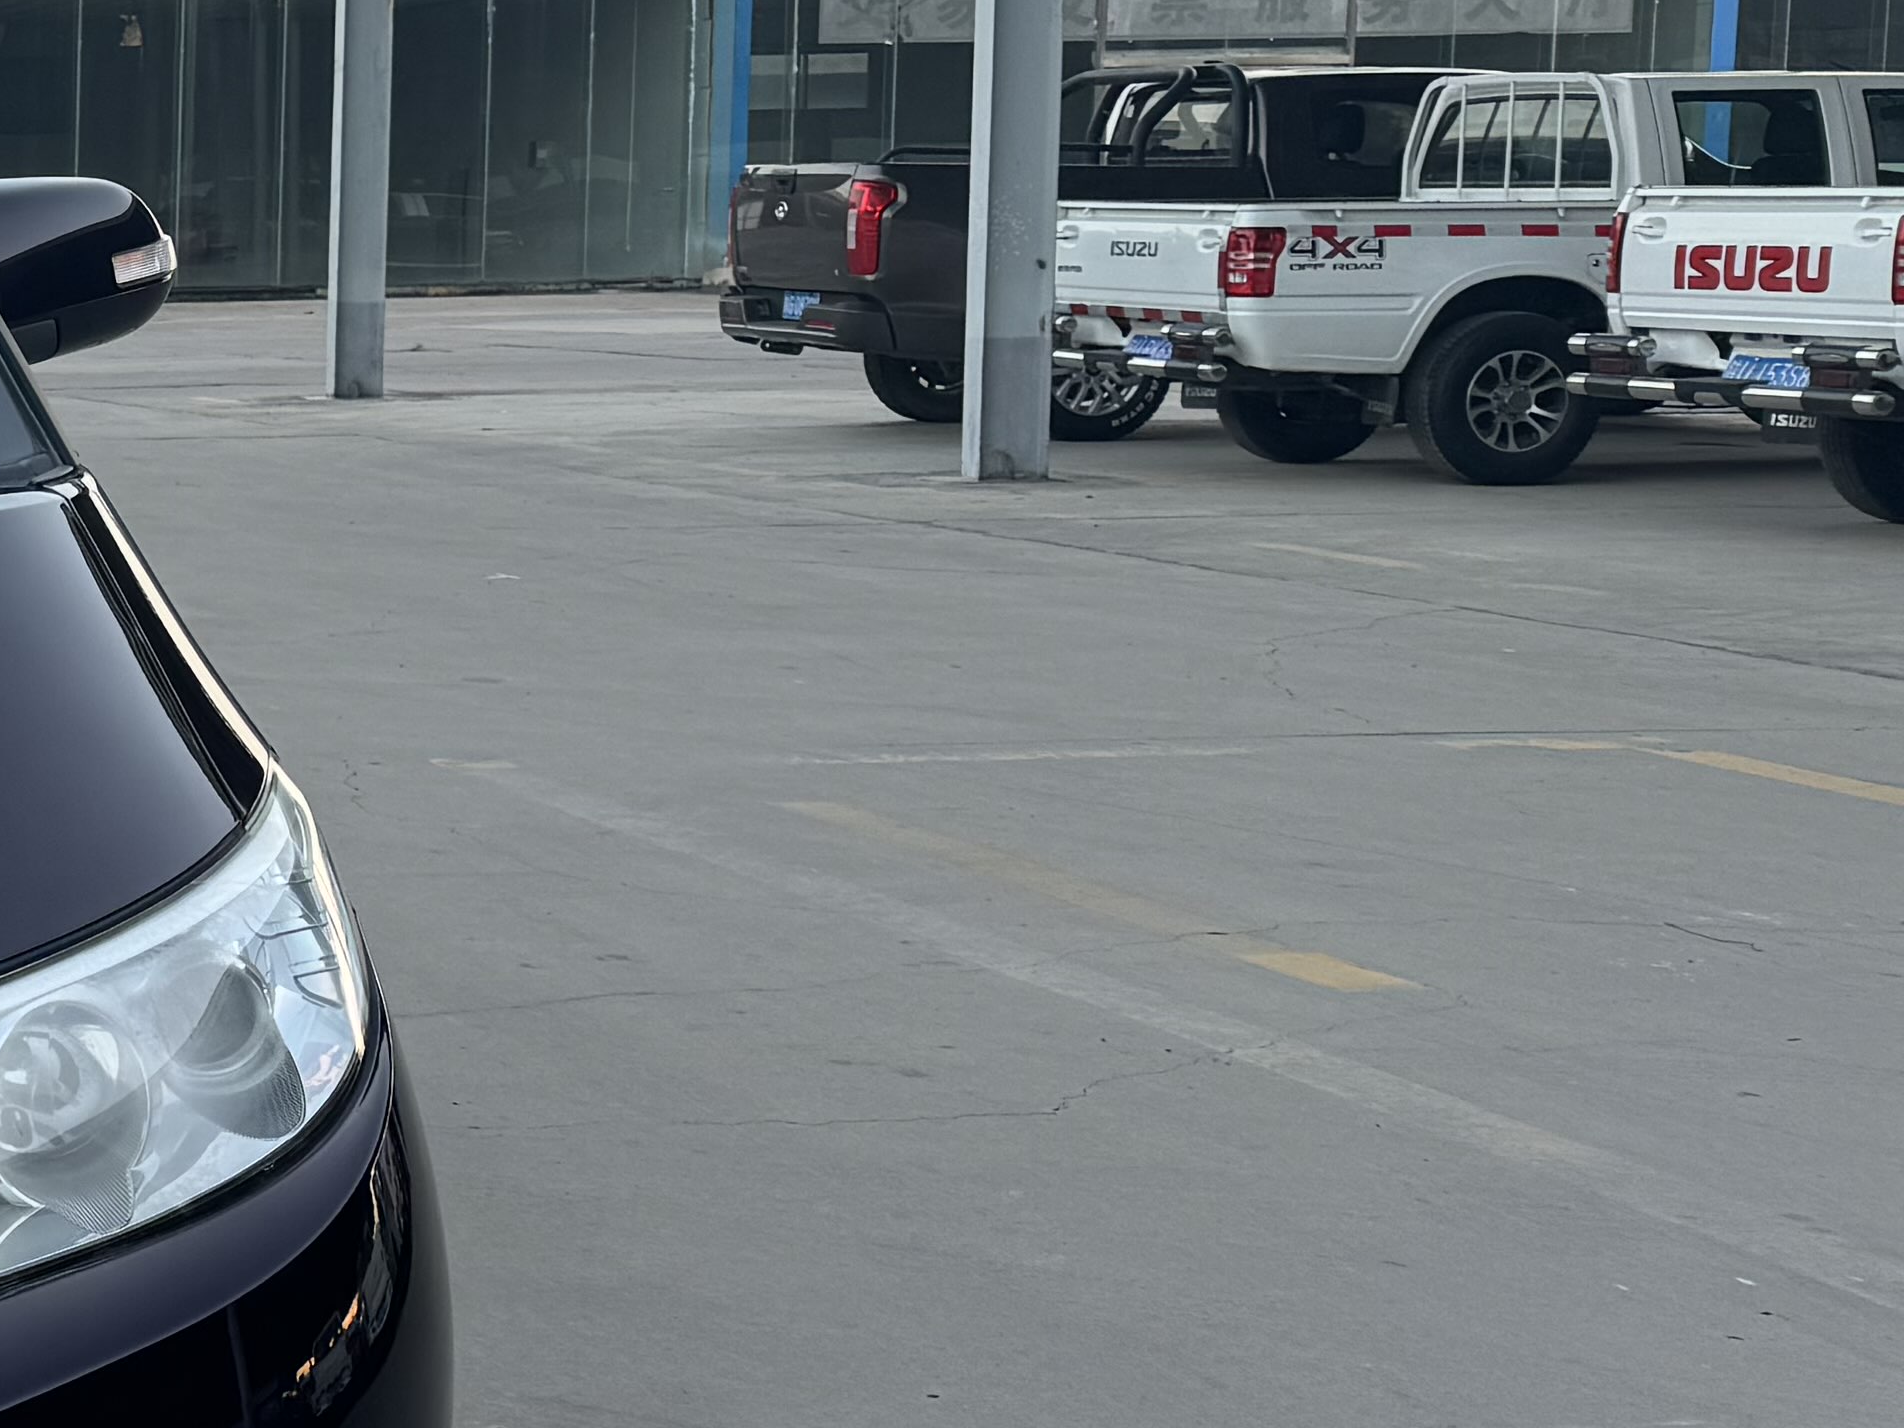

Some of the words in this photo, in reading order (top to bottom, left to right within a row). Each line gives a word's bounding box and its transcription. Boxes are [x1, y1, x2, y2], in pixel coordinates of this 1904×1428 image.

[1110, 240, 1159, 257] ISUZU
[1289, 263, 1325, 271] OFF
[1333, 263, 1383, 271] ROAD
[1673, 244, 1833, 293] ISUZU
[1769, 413, 1817, 429] ISUZU
